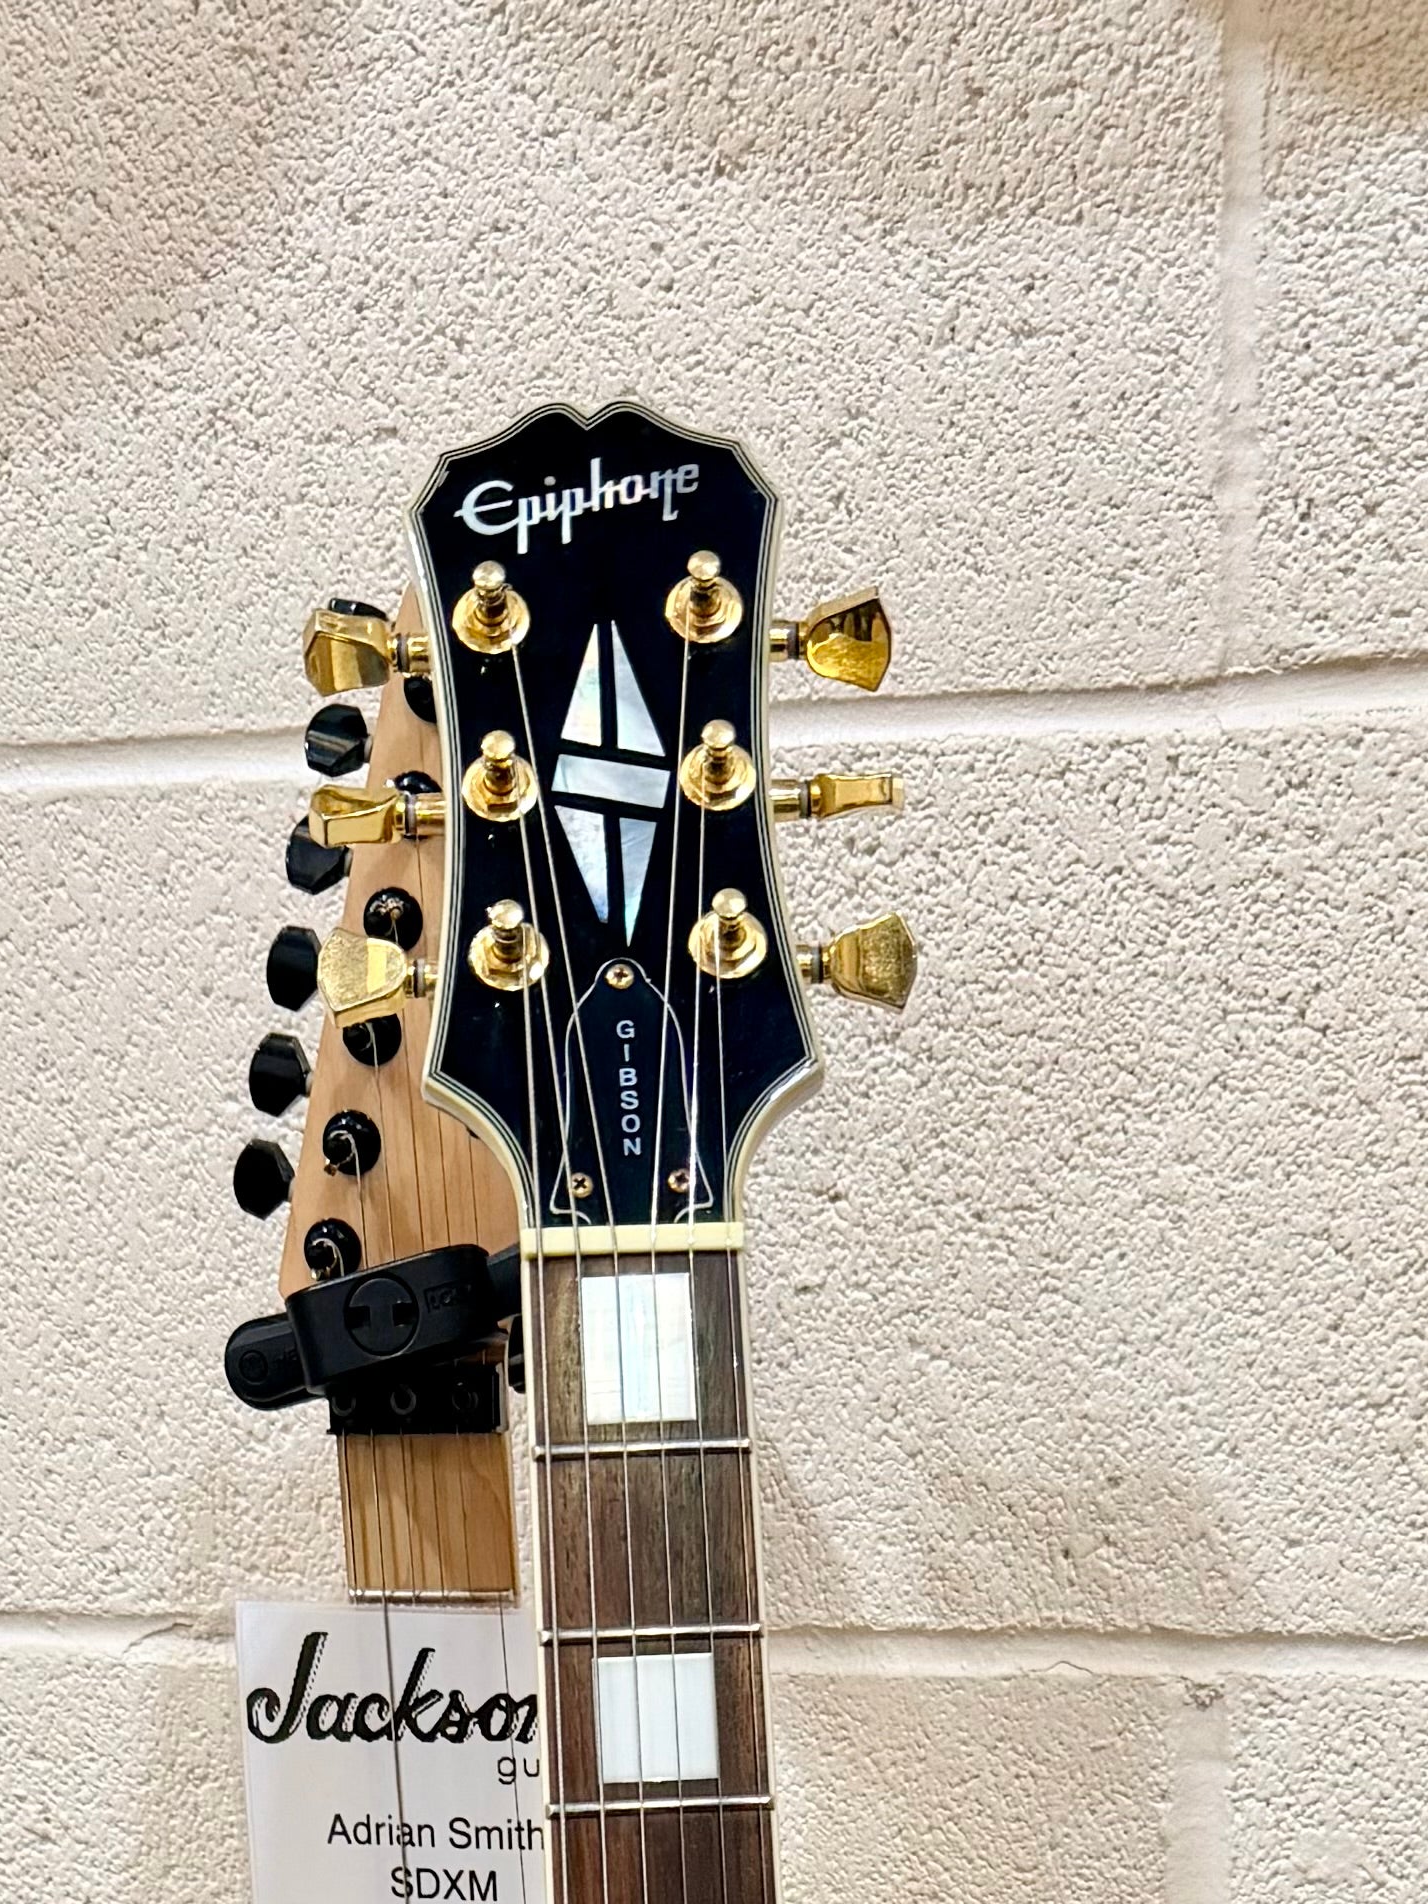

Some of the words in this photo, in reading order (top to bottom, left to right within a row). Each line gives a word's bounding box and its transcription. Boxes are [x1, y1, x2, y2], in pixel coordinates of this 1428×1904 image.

[453, 458, 699, 553] Epiphone
[616, 1019, 641, 1157] GIBSON
[327, 1814, 435, 1848] Adrian
[449, 1817, 544, 1851] Smith
[391, 1868, 497, 1902] SDXM
